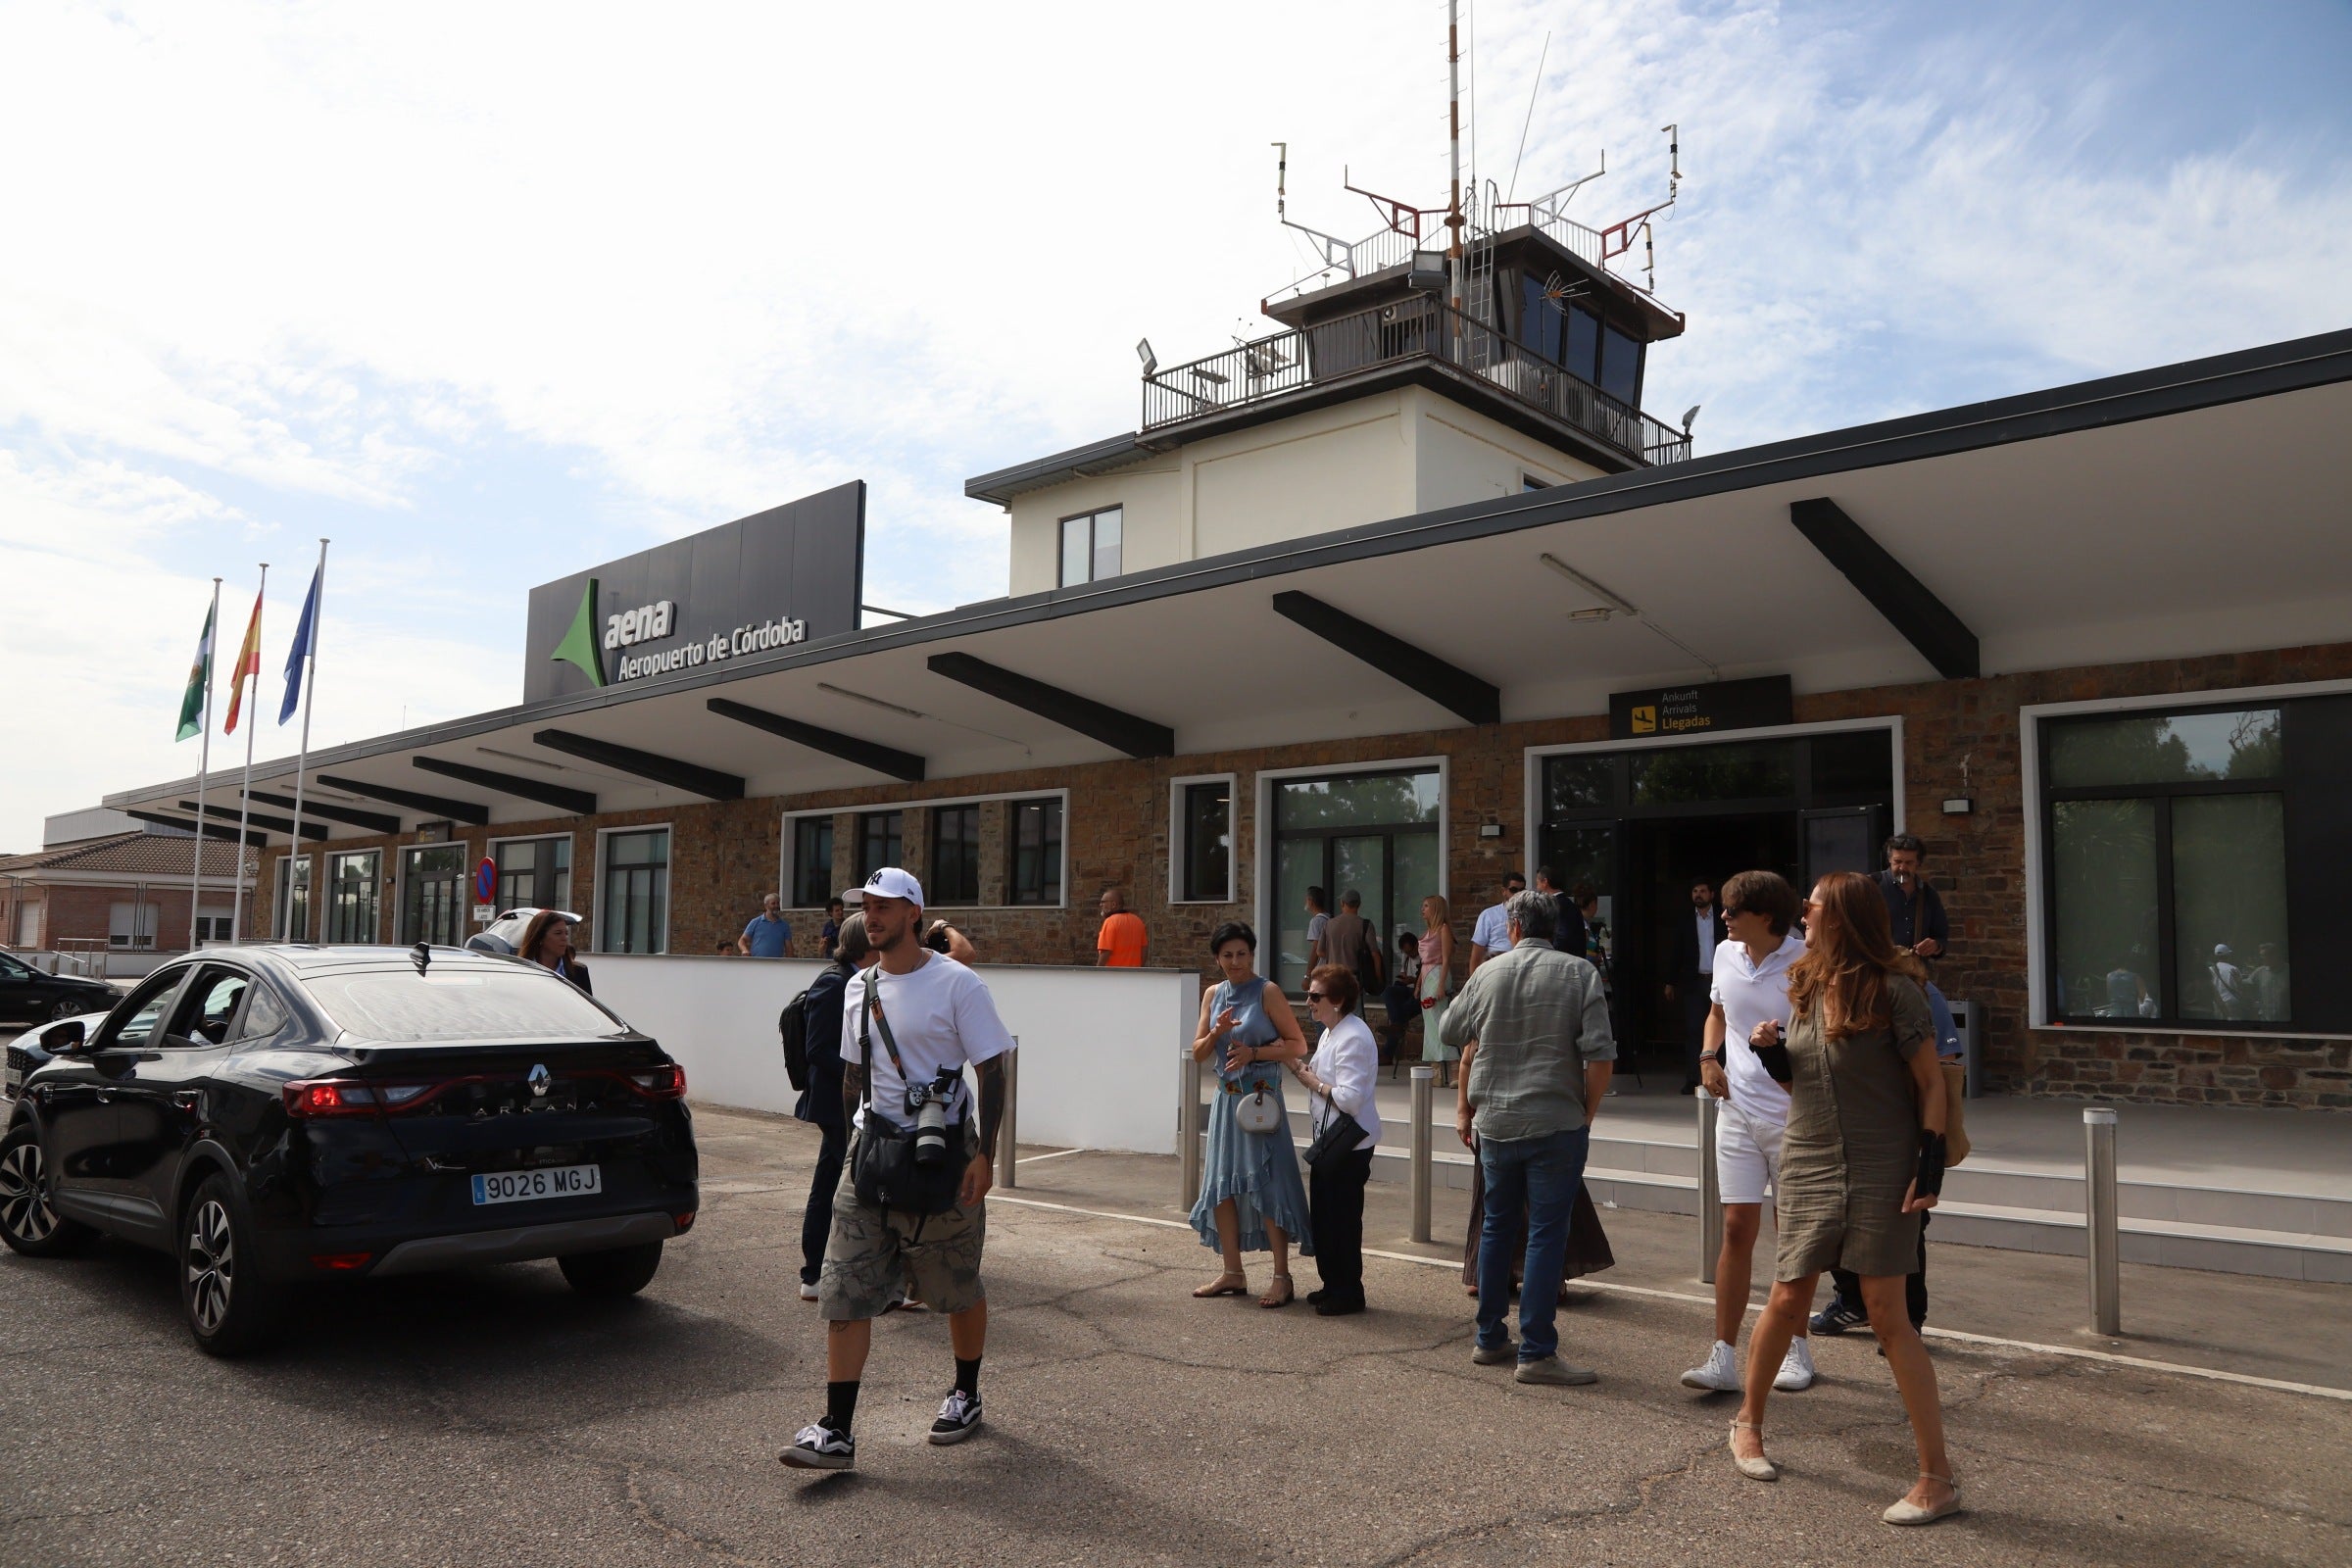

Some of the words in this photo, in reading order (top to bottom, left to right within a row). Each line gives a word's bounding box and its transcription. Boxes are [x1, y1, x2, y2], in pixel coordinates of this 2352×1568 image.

[604, 600, 674, 650] aena
[618, 642, 706, 681] Aeropuerto
[707, 633, 730, 662] de
[732, 616, 807, 656] Córdoba
[1662, 689, 1698, 704] Ankunft
[1662, 703, 1697, 716] Arrivals
[1662, 715, 1711, 730] Llegadas
[474, 1102, 598, 1116] ARKANA
[487, 1173, 546, 1200] 9026
[554, 1167, 596, 1193] MGJ
